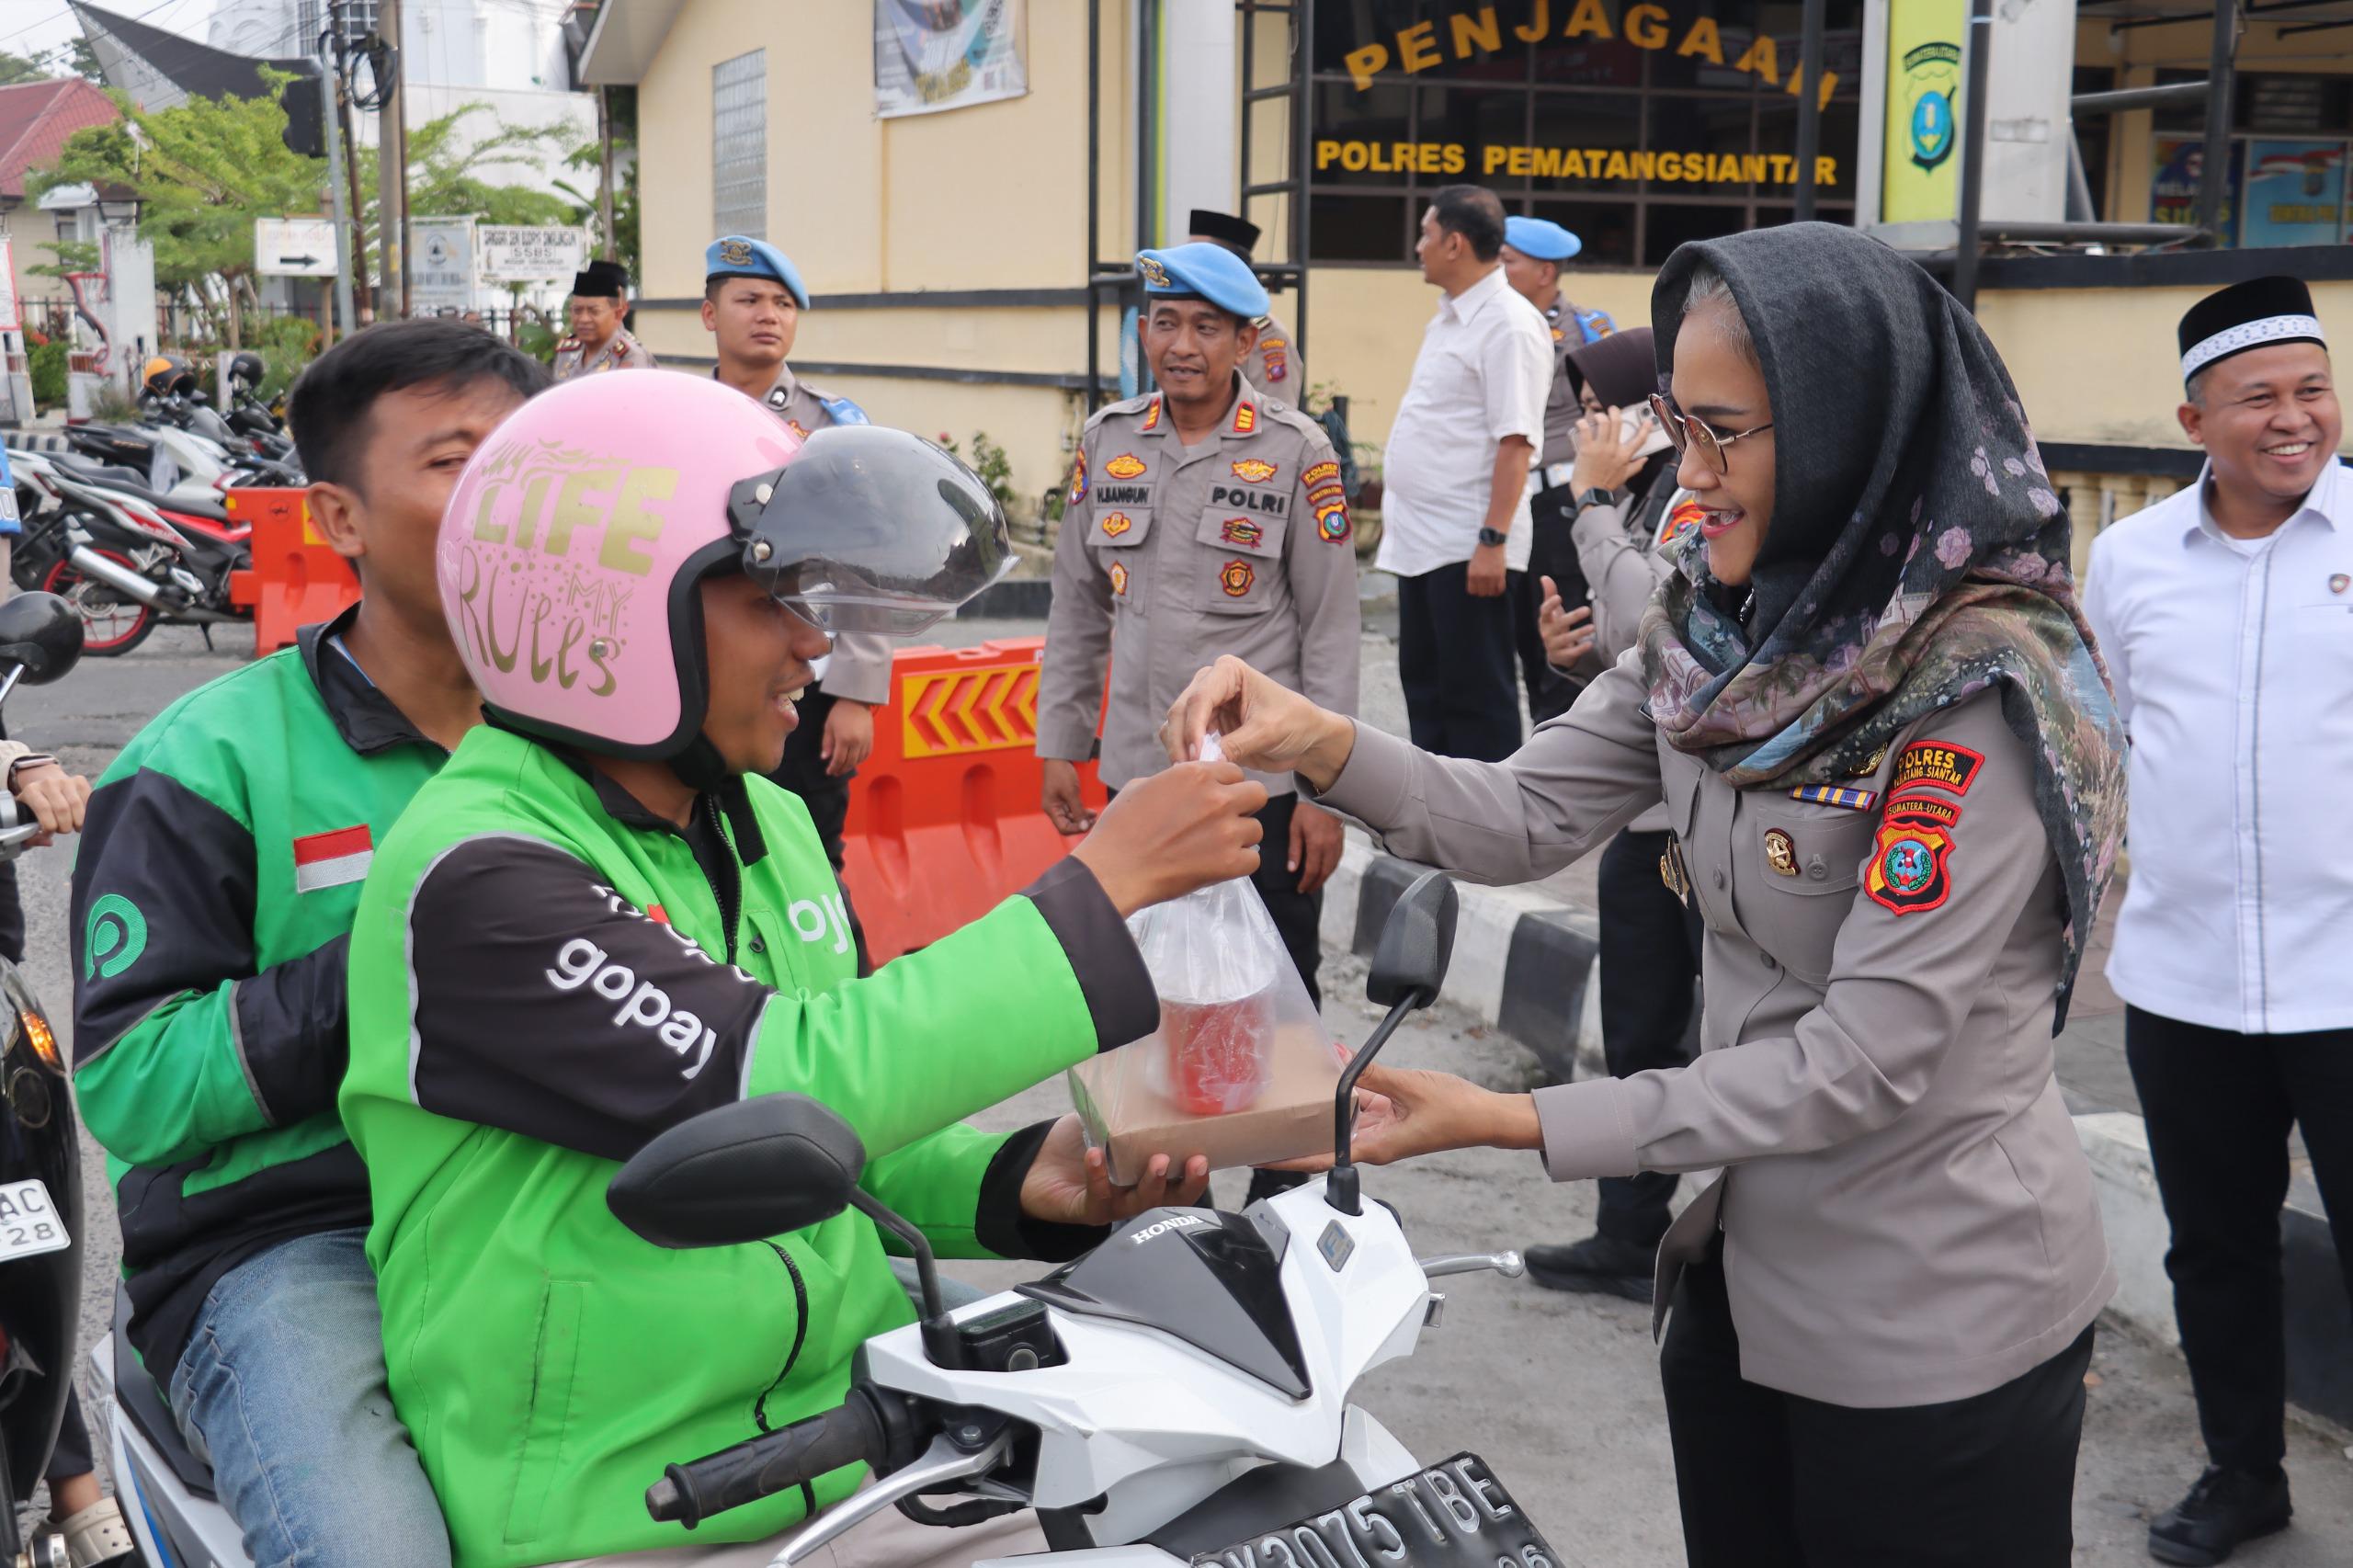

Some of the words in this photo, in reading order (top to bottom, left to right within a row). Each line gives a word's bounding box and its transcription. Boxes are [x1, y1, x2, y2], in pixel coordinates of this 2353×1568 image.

[1344, 0, 1838, 112] PENJAGAAN
[1316, 141, 1465, 174] POLRES
[1211, 486, 1286, 513] POLRI
[472, 466, 680, 577] LIFE
[566, 573, 634, 636] MY
[1898, 748, 1956, 772] POLRES
[1927, 767, 1963, 786] SIANTAR
[1888, 801, 1923, 815] SUMATERA
[1926, 802, 1953, 820] UTARA
[545, 937, 718, 1080] gopay
[1130, 1215, 1205, 1244] HONDA
[1392, 1458, 1511, 1542] TBE
